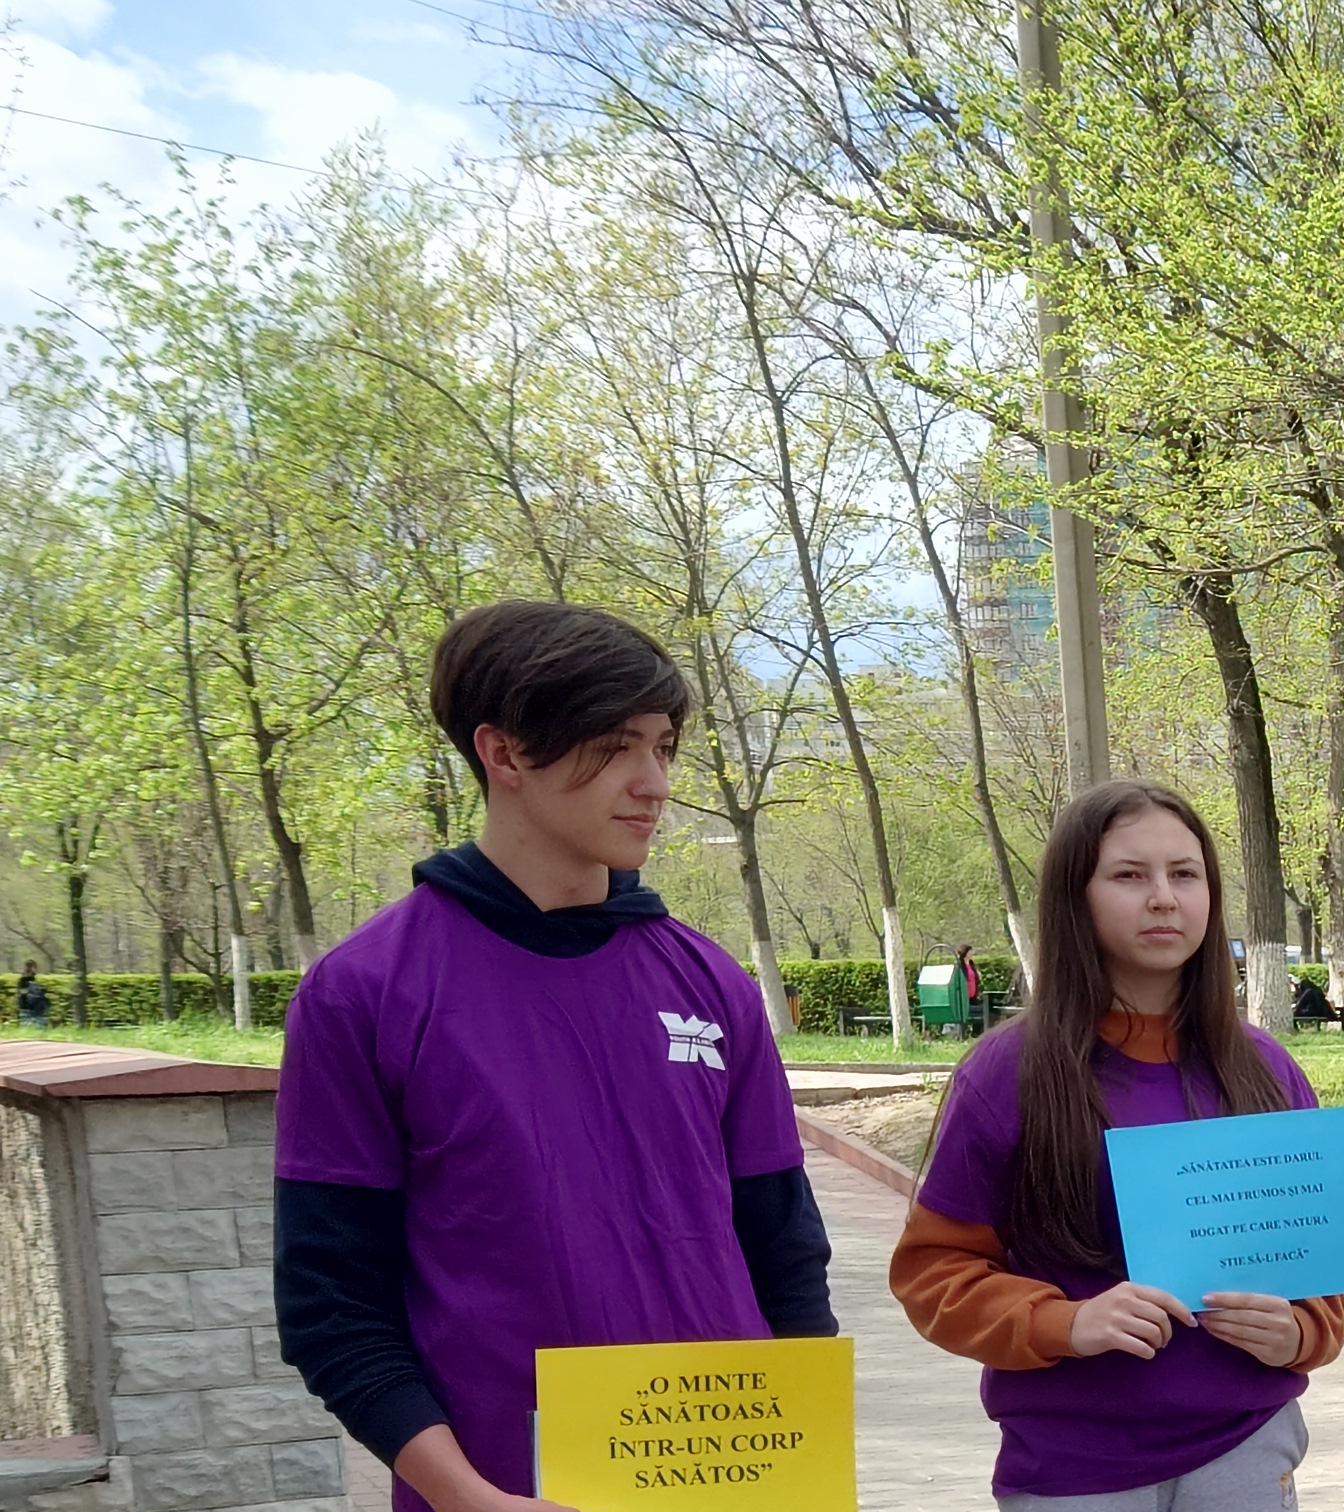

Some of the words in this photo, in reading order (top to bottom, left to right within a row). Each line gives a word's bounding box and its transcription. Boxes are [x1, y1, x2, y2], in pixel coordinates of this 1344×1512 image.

[1253, 1156, 1281, 1168] ESTE
[1283, 1151, 1323, 1164] DARUL
[1186, 1193, 1210, 1206] CEL
[1212, 1192, 1235, 1204] MAI
[1238, 1187, 1286, 1202] FRUMOS
[1302, 1183, 1324, 1195] MAI
[1189, 1224, 1231, 1239] BOGAT
[1233, 1223, 1247, 1235] PE
[1249, 1219, 1281, 1232] CARE
[1283, 1215, 1329, 1229] NATURA
[1247, 1251, 1274, 1266] SĂ-L
[636, 1376, 669, 1399] „O
[678, 1372, 767, 1394] MINTE
[619, 1396, 783, 1427] SĂNĂTOASĂ
[609, 1436, 722, 1460] ÎNTR-UN
[731, 1431, 804, 1452] CORP
[635, 1462, 773, 1489] SĂNĂTOS”
